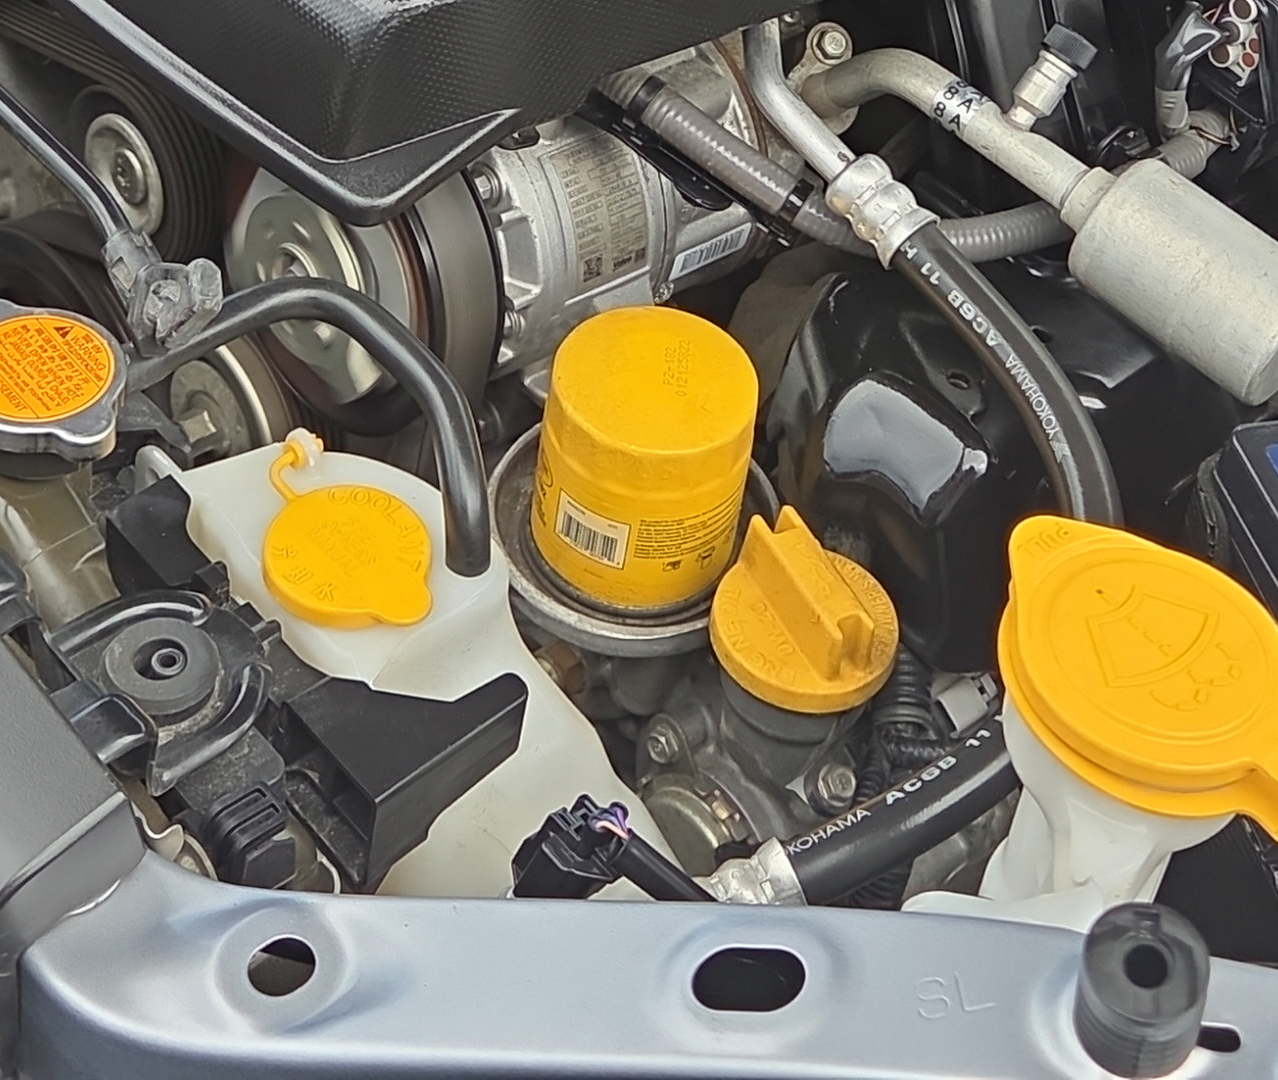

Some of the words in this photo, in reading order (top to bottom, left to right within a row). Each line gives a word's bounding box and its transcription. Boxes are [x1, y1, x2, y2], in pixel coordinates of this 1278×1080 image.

[918, 260, 944, 286] 11
[945, 287, 1003, 348] AC6B
[9, 325, 32, 350] NEVER
[28, 346, 48, 368] OPEN
[45, 364, 66, 387] WHEN
[69, 333, 106, 374] WARNING
[1001, 352, 1057, 438] YOKOHAMA
[327, 486, 424, 572] COOLANT
[1017, 530, 1071, 558] PULL
[718, 585, 742, 615] OIL
[725, 618, 795, 685] ENGINE
[785, 808, 872, 856] KOHAMA
[964, 727, 992, 753] 11
[917, 970, 998, 1020] SL
